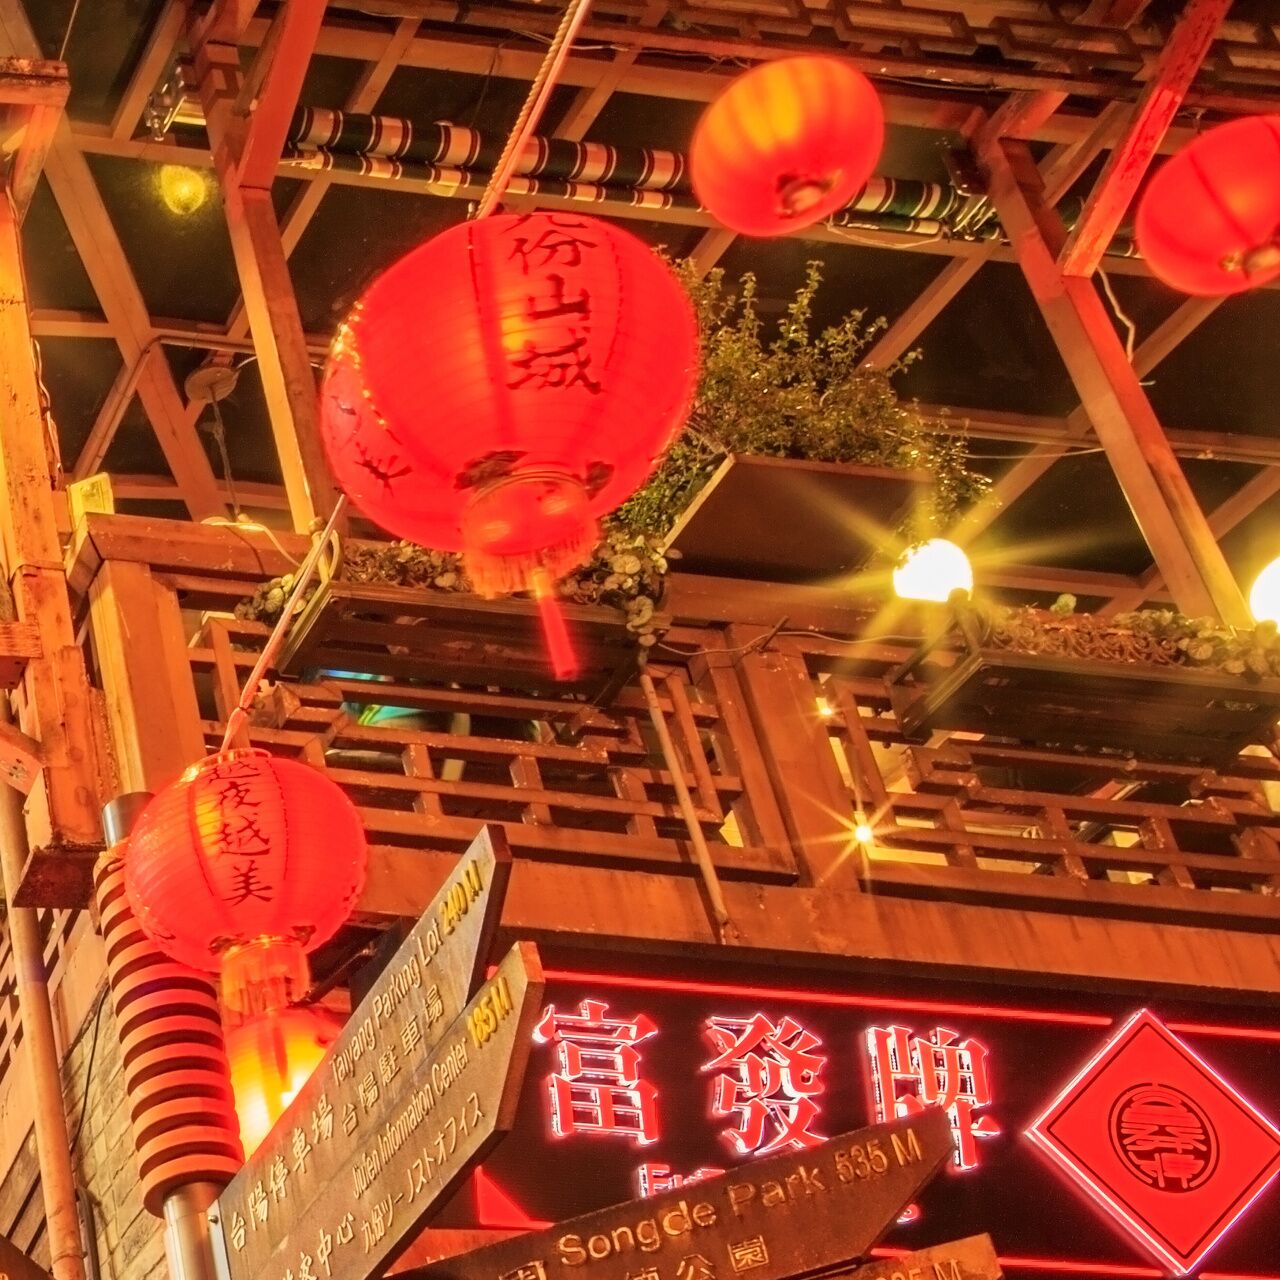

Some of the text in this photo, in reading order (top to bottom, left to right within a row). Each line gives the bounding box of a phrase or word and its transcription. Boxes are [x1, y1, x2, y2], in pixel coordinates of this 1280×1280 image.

[209, 759, 273, 907] 越夜越美
[328, 1014, 377, 1087] Taiyang
[371, 953, 423, 1031] Parking
[416, 920, 445, 968] Lot
[341, 982, 445, 1138] 台陽駐車場
[352, 1147, 382, 1201] Jiufen
[378, 1083, 434, 1168] Information
[431, 1037, 470, 1097] Center
[531, 996, 1004, 1173] 富發牌
[230, 1092, 336, 1252] 台陽停車場
[558, 1197, 718, 1267] Songde
[730, 1163, 827, 1220] Park
[834, 1136, 890, 1185] 535
[892, 1125, 923, 1163] M
